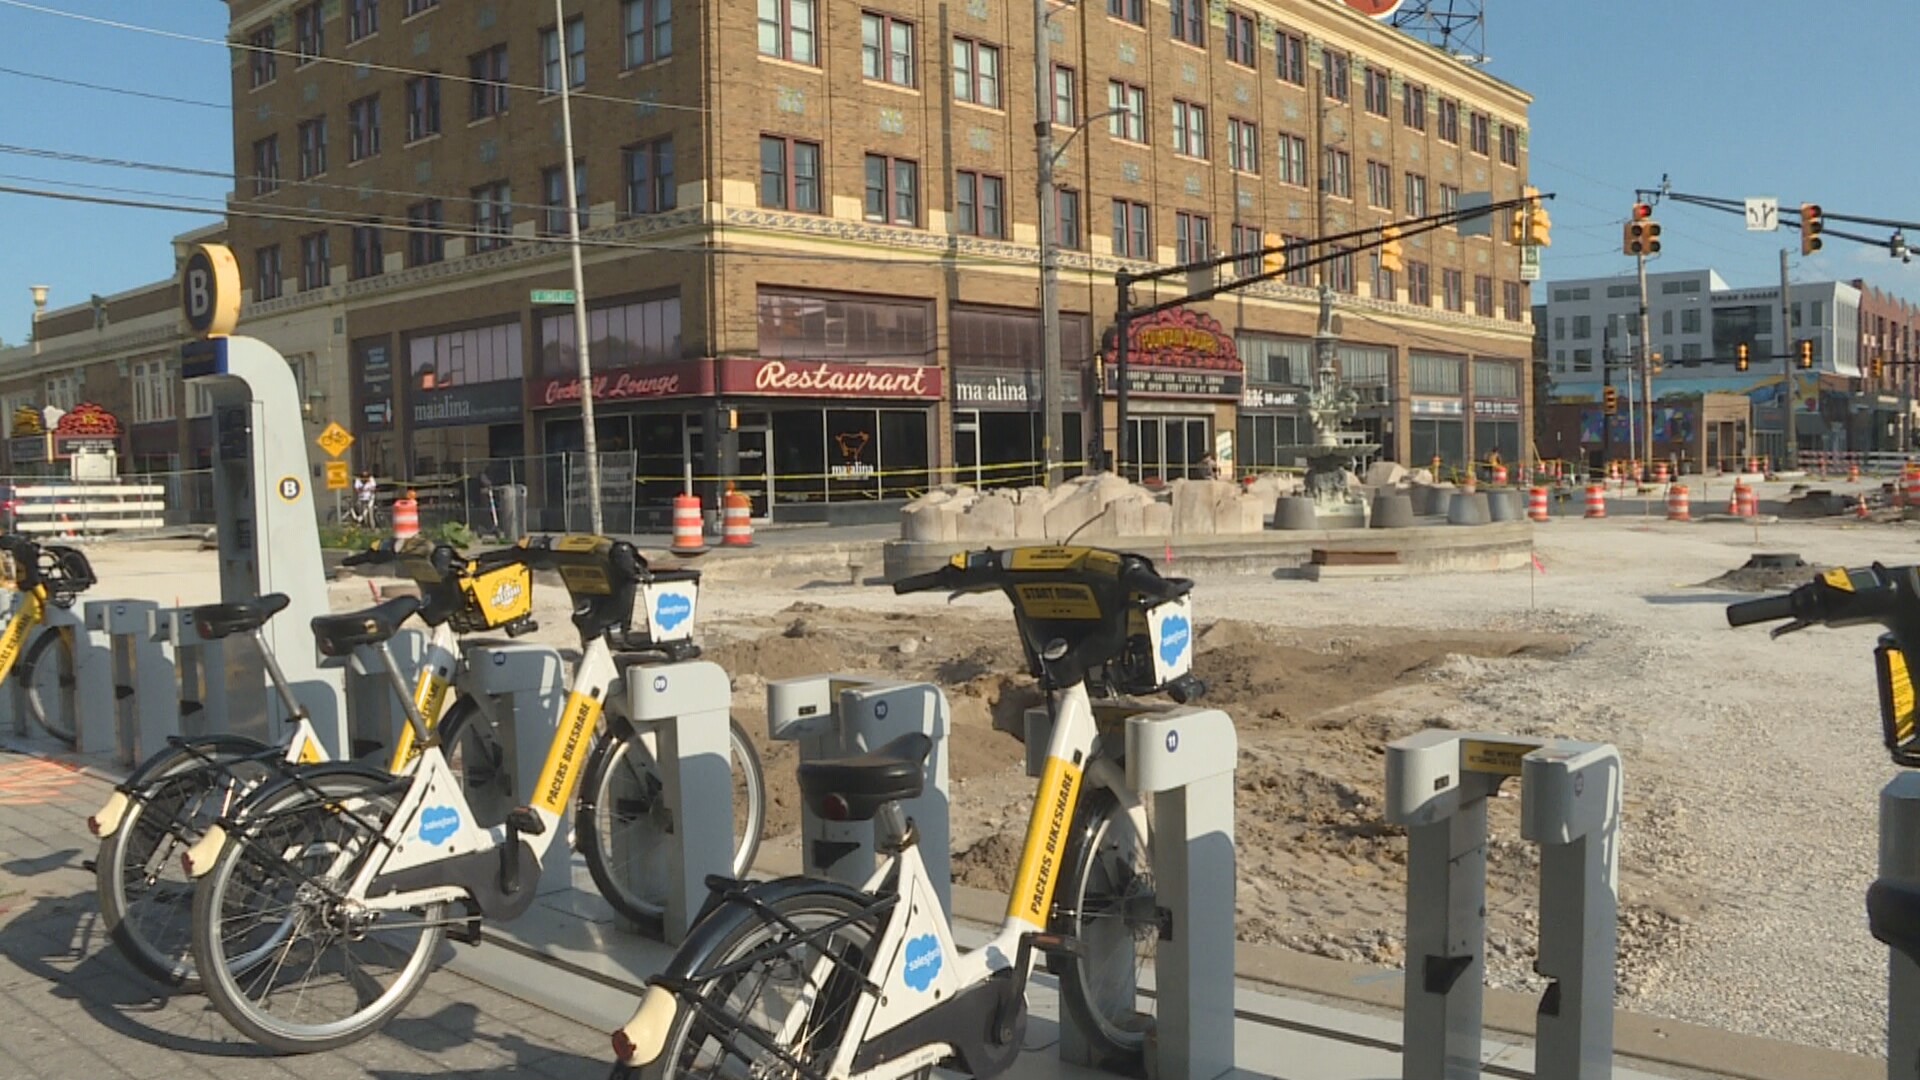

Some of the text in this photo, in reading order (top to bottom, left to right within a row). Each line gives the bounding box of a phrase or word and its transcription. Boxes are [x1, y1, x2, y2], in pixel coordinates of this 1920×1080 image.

[189, 268, 209, 317] B
[608, 373, 680, 396] Lounge
[755, 361, 928, 395] Restaurant
[414, 395, 471, 421] maialina
[282, 480, 298, 498] B
[546, 701, 591, 806] PACERS BIKESHARE
[1030, 770, 1074, 916] PACERS BIKESHARE
